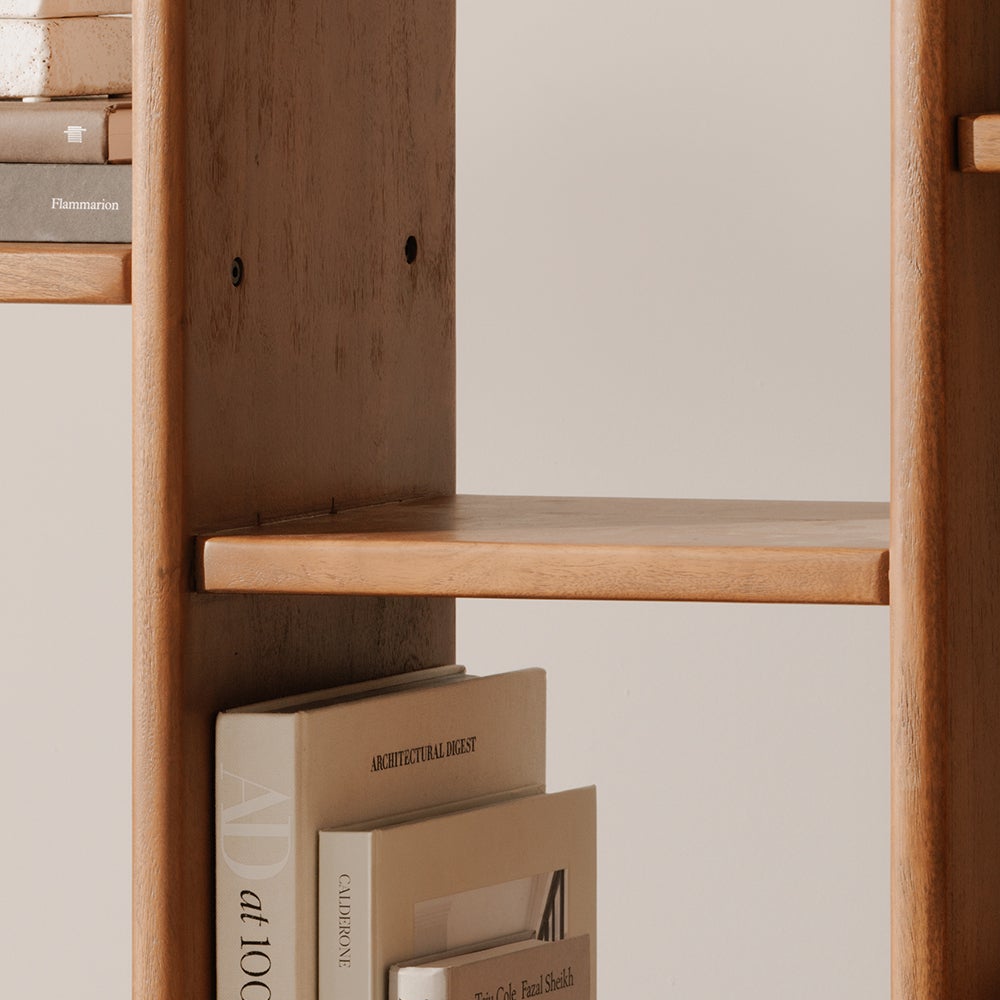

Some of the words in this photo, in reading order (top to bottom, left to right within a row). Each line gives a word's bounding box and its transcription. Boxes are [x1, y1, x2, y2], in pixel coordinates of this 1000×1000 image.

[51, 197, 119, 210] Flammarion
[370, 742, 445, 772] ARCHITECTURAL
[446, 736, 477, 757] DIGEST
[220, 762, 292, 880] AD
[240, 889, 269, 926] at
[338, 873, 351, 968] CALDERONE
[521, 975, 543, 1000] Fazal
[545, 966, 574, 993] Sheikh
